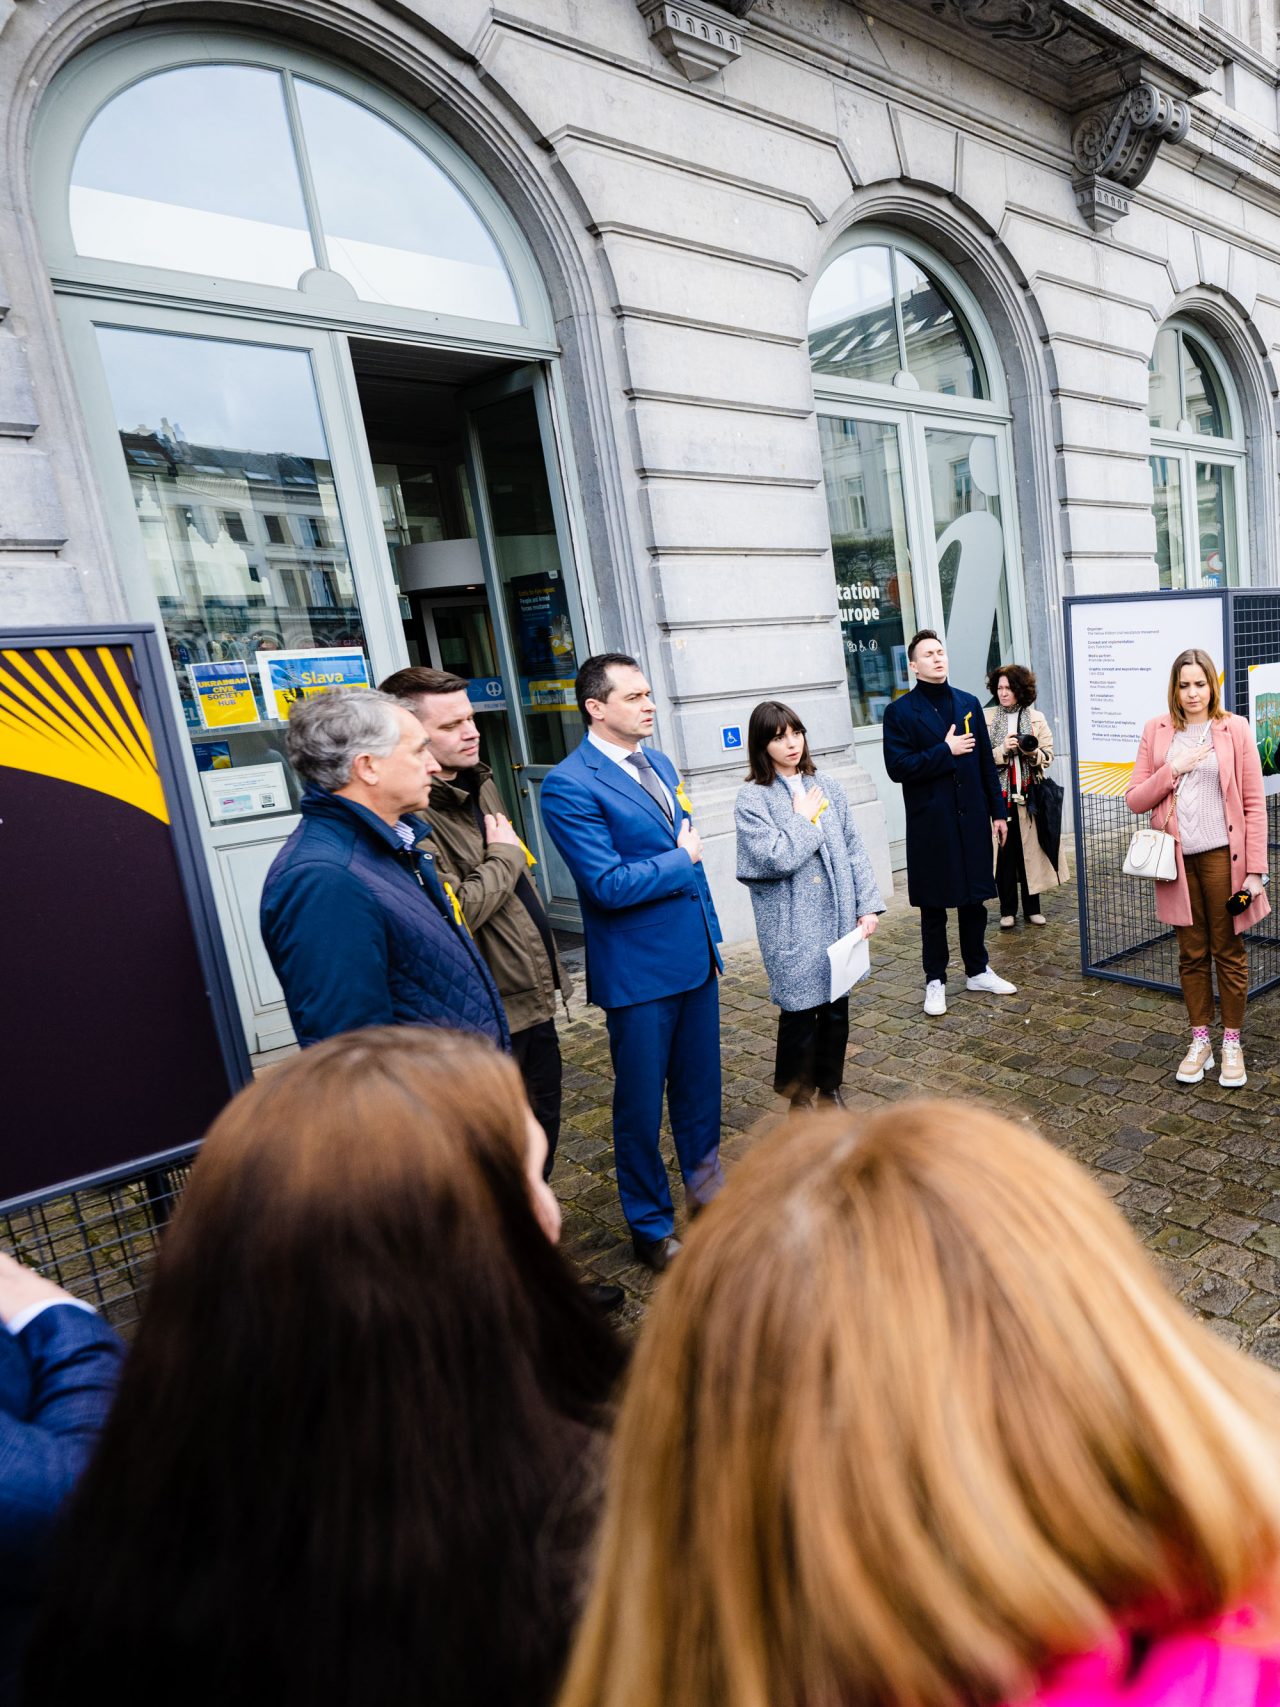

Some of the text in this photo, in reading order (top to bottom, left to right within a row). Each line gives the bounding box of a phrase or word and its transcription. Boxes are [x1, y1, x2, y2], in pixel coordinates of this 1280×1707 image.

[197, 677, 248, 687] UKRAINIAN
[300, 671, 344, 686] Slava
[212, 685, 235, 694] CIVIL
[207, 692, 245, 701] SOCIETY
